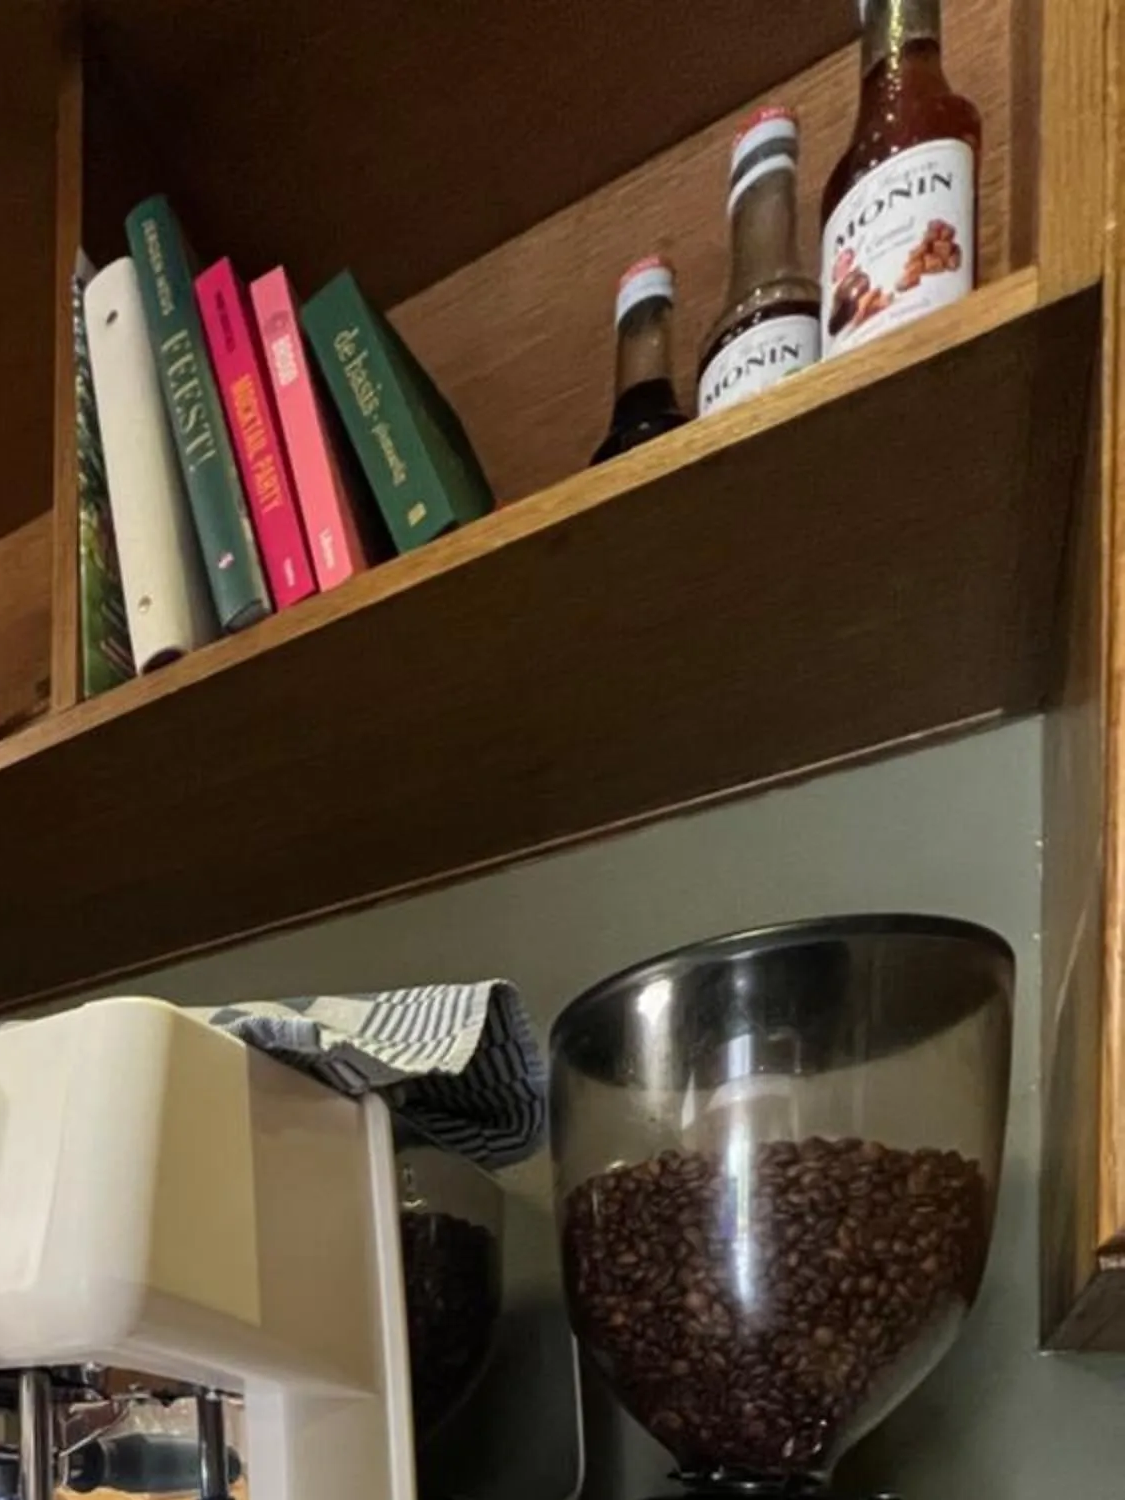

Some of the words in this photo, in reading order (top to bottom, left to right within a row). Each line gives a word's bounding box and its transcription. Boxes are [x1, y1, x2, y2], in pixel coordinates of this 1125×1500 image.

[835, 172, 952, 249] MONIN
[333, 326, 360, 363] de
[703, 343, 801, 410] MONIN
[160, 329, 217, 473] FEEST!
[250, 453, 282, 515] PARTY
